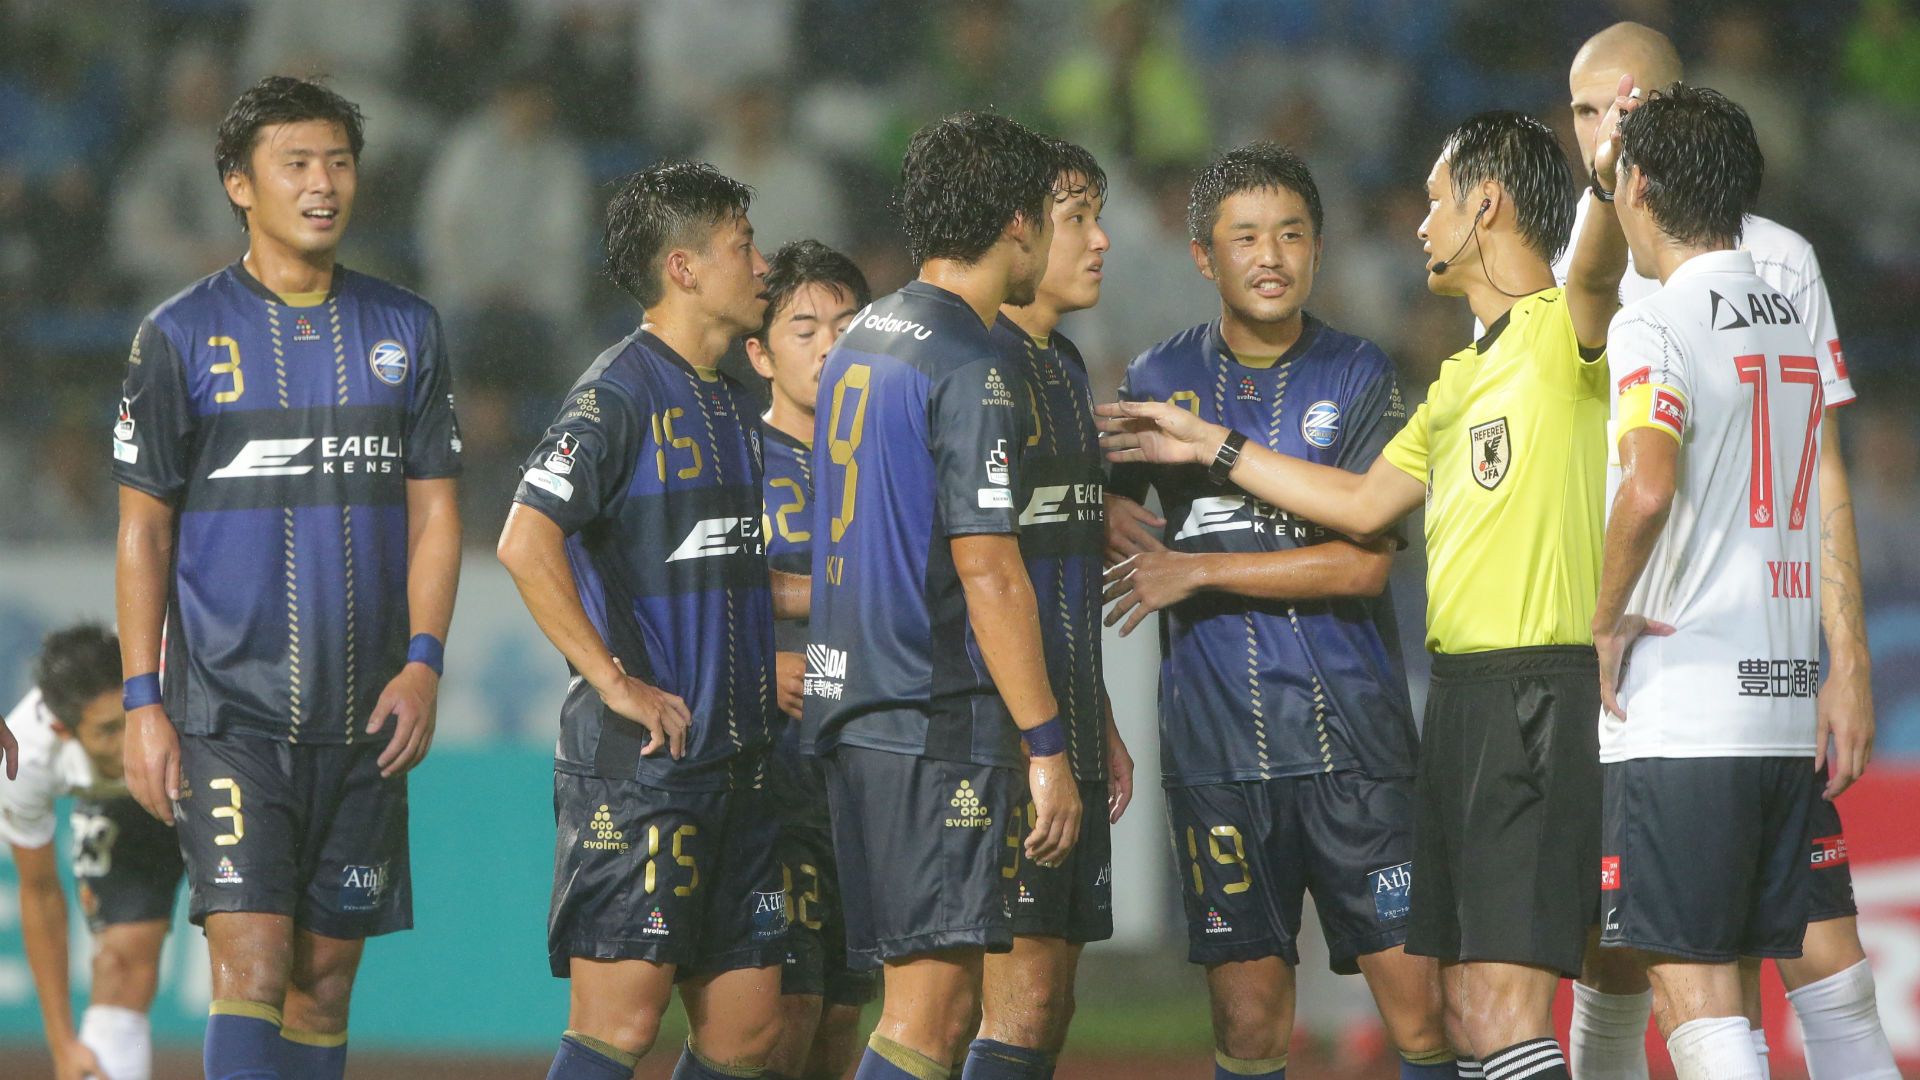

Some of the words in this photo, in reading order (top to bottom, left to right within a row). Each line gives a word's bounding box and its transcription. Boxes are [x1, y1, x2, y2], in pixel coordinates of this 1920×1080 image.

[864, 312, 933, 341] odakyu
[208, 336, 245, 404] 3
[982, 397, 1015, 407] svolme
[568, 409, 601, 423] svolme
[1474, 424, 1505, 442] REFEREE
[1733, 354, 1824, 531] 17
[322, 436, 403, 458] EAGL
[652, 407, 703, 483] 15
[828, 363, 871, 543] 9
[323, 461, 403, 474] KENS
[1482, 468, 1500, 481] JFA
[1767, 561, 1812, 599] YUKI
[209, 777, 245, 846] 3
[945, 815, 993, 828] svolme
[583, 839, 629, 850] svolme
[644, 824, 699, 897] 15
[1187, 825, 1251, 896] 19
[1811, 849, 1837, 863] GR
[643, 927, 670, 936] svolme
[1205, 926, 1233, 934] svolme
